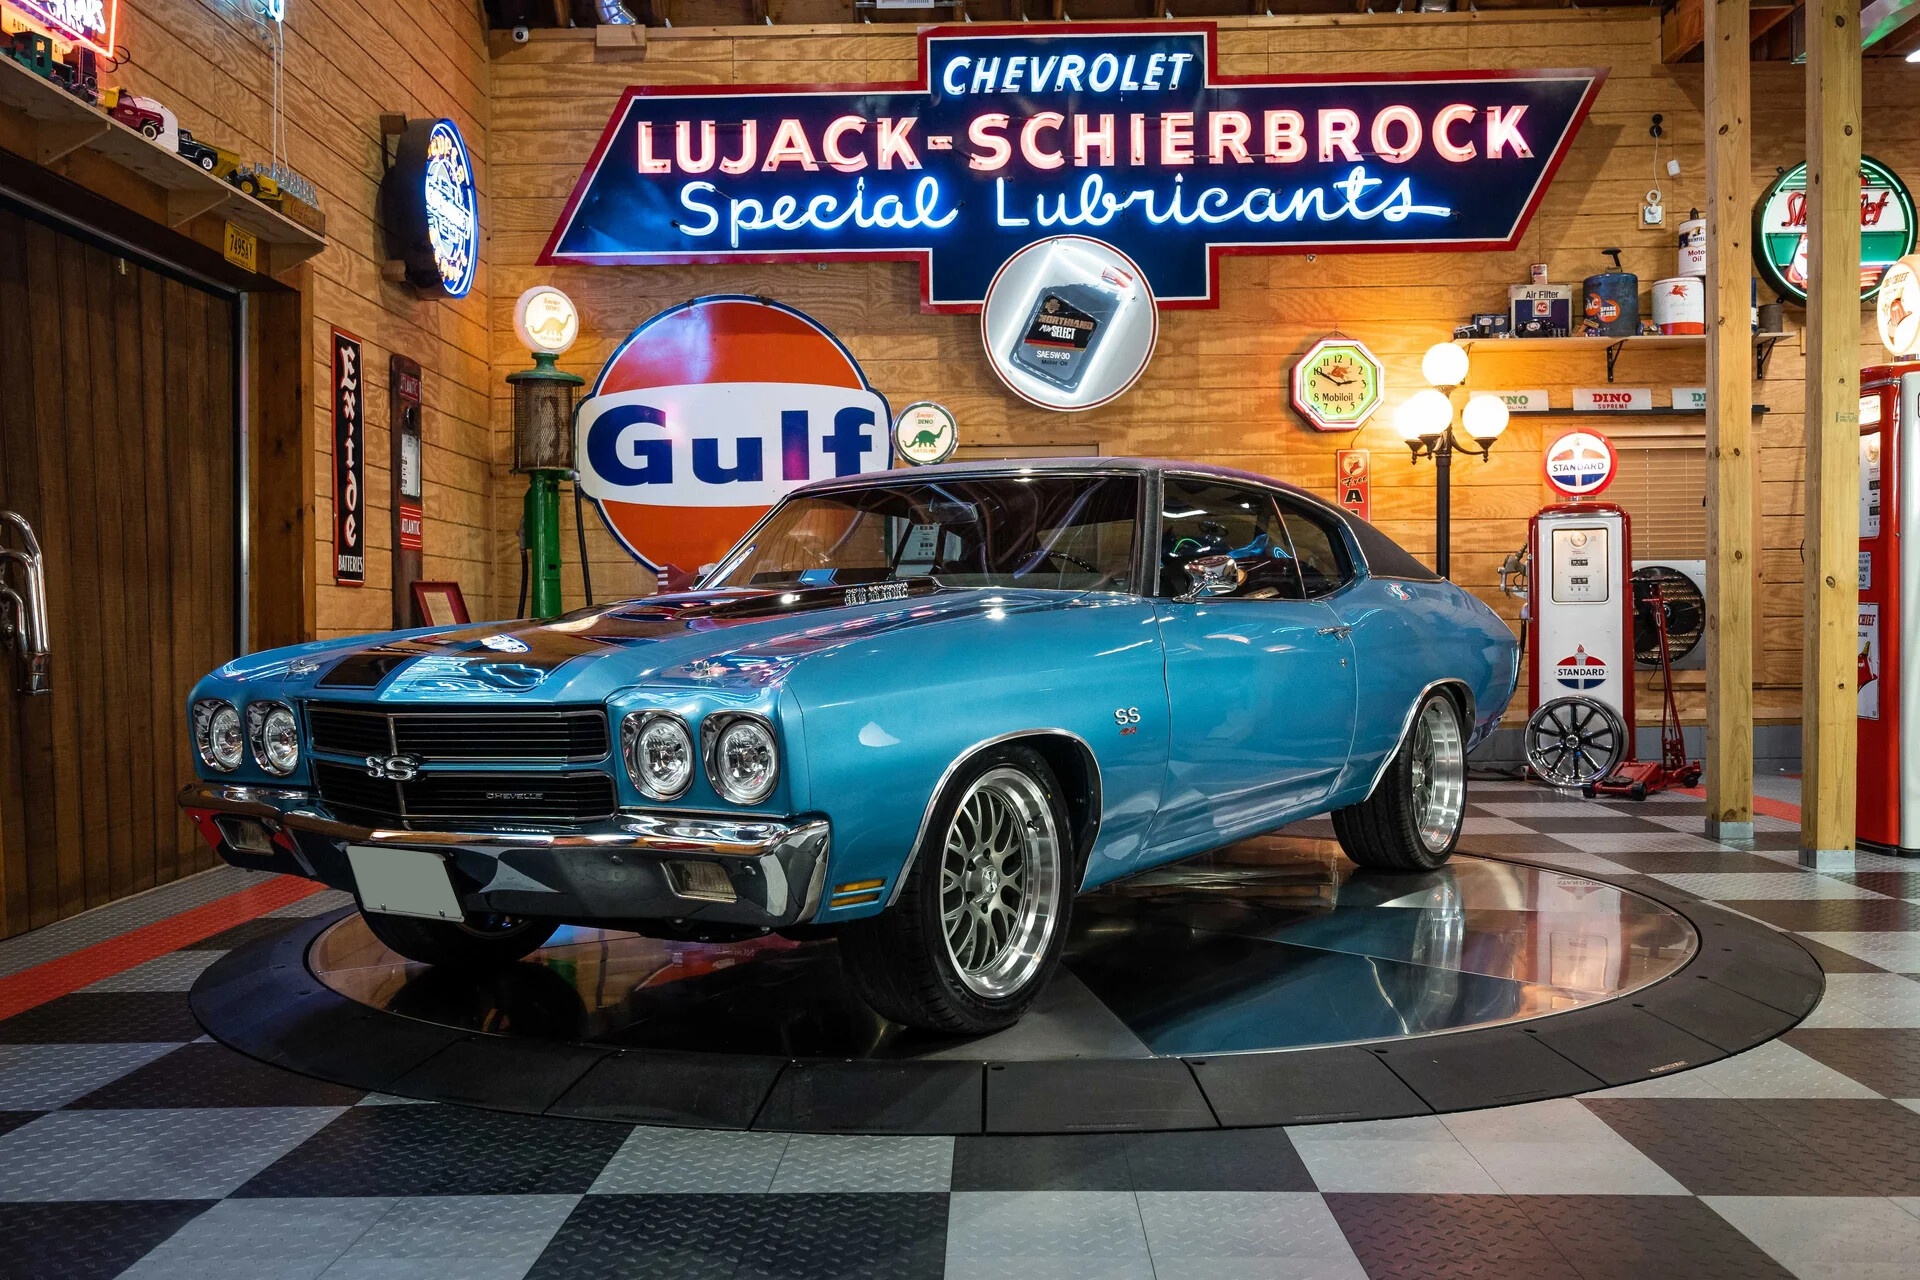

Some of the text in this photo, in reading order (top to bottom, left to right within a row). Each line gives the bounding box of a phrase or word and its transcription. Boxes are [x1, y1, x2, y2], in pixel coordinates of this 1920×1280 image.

[943, 53, 1193, 94] CHEVROLET
[638, 104, 1535, 174] LUJACK-SCHIERBROCK
[679, 165, 1451, 248] Special Lubricants
[1687, 249, 1705, 257] Moto
[1526, 290, 1560, 299] Air Filter
[1585, 297, 1600, 310] AC
[1051, 325, 1076, 340] SELECT
[1036, 350, 1071, 360] SAE 5W-30
[1334, 354, 1343, 364] 12
[1323, 358, 1330, 366] 11
[1349, 357, 1353, 366] 1
[1358, 366, 1363, 375] 2
[1310, 380, 1316, 388] 9
[1361, 379, 1367, 388] 3
[1313, 392, 1320, 402] 8
[1322, 393, 1354, 402] Mobiloil
[1358, 392, 1364, 401] 4
[1592, 393, 1632, 403] DINO
[1336, 404, 1342, 414] 6
[1350, 401, 1355, 410] 5
[340, 346, 358, 548] Exide
[587, 404, 876, 487] Gulf
[1553, 462, 1604, 472] STANDARD
[338, 554, 363, 574] BATTERIES
[1558, 668, 1605, 676] STANDARD
[1114, 707, 1141, 725] SS
[366, 755, 417, 781] SS
[486, 792, 544, 800] CHEVELLE
